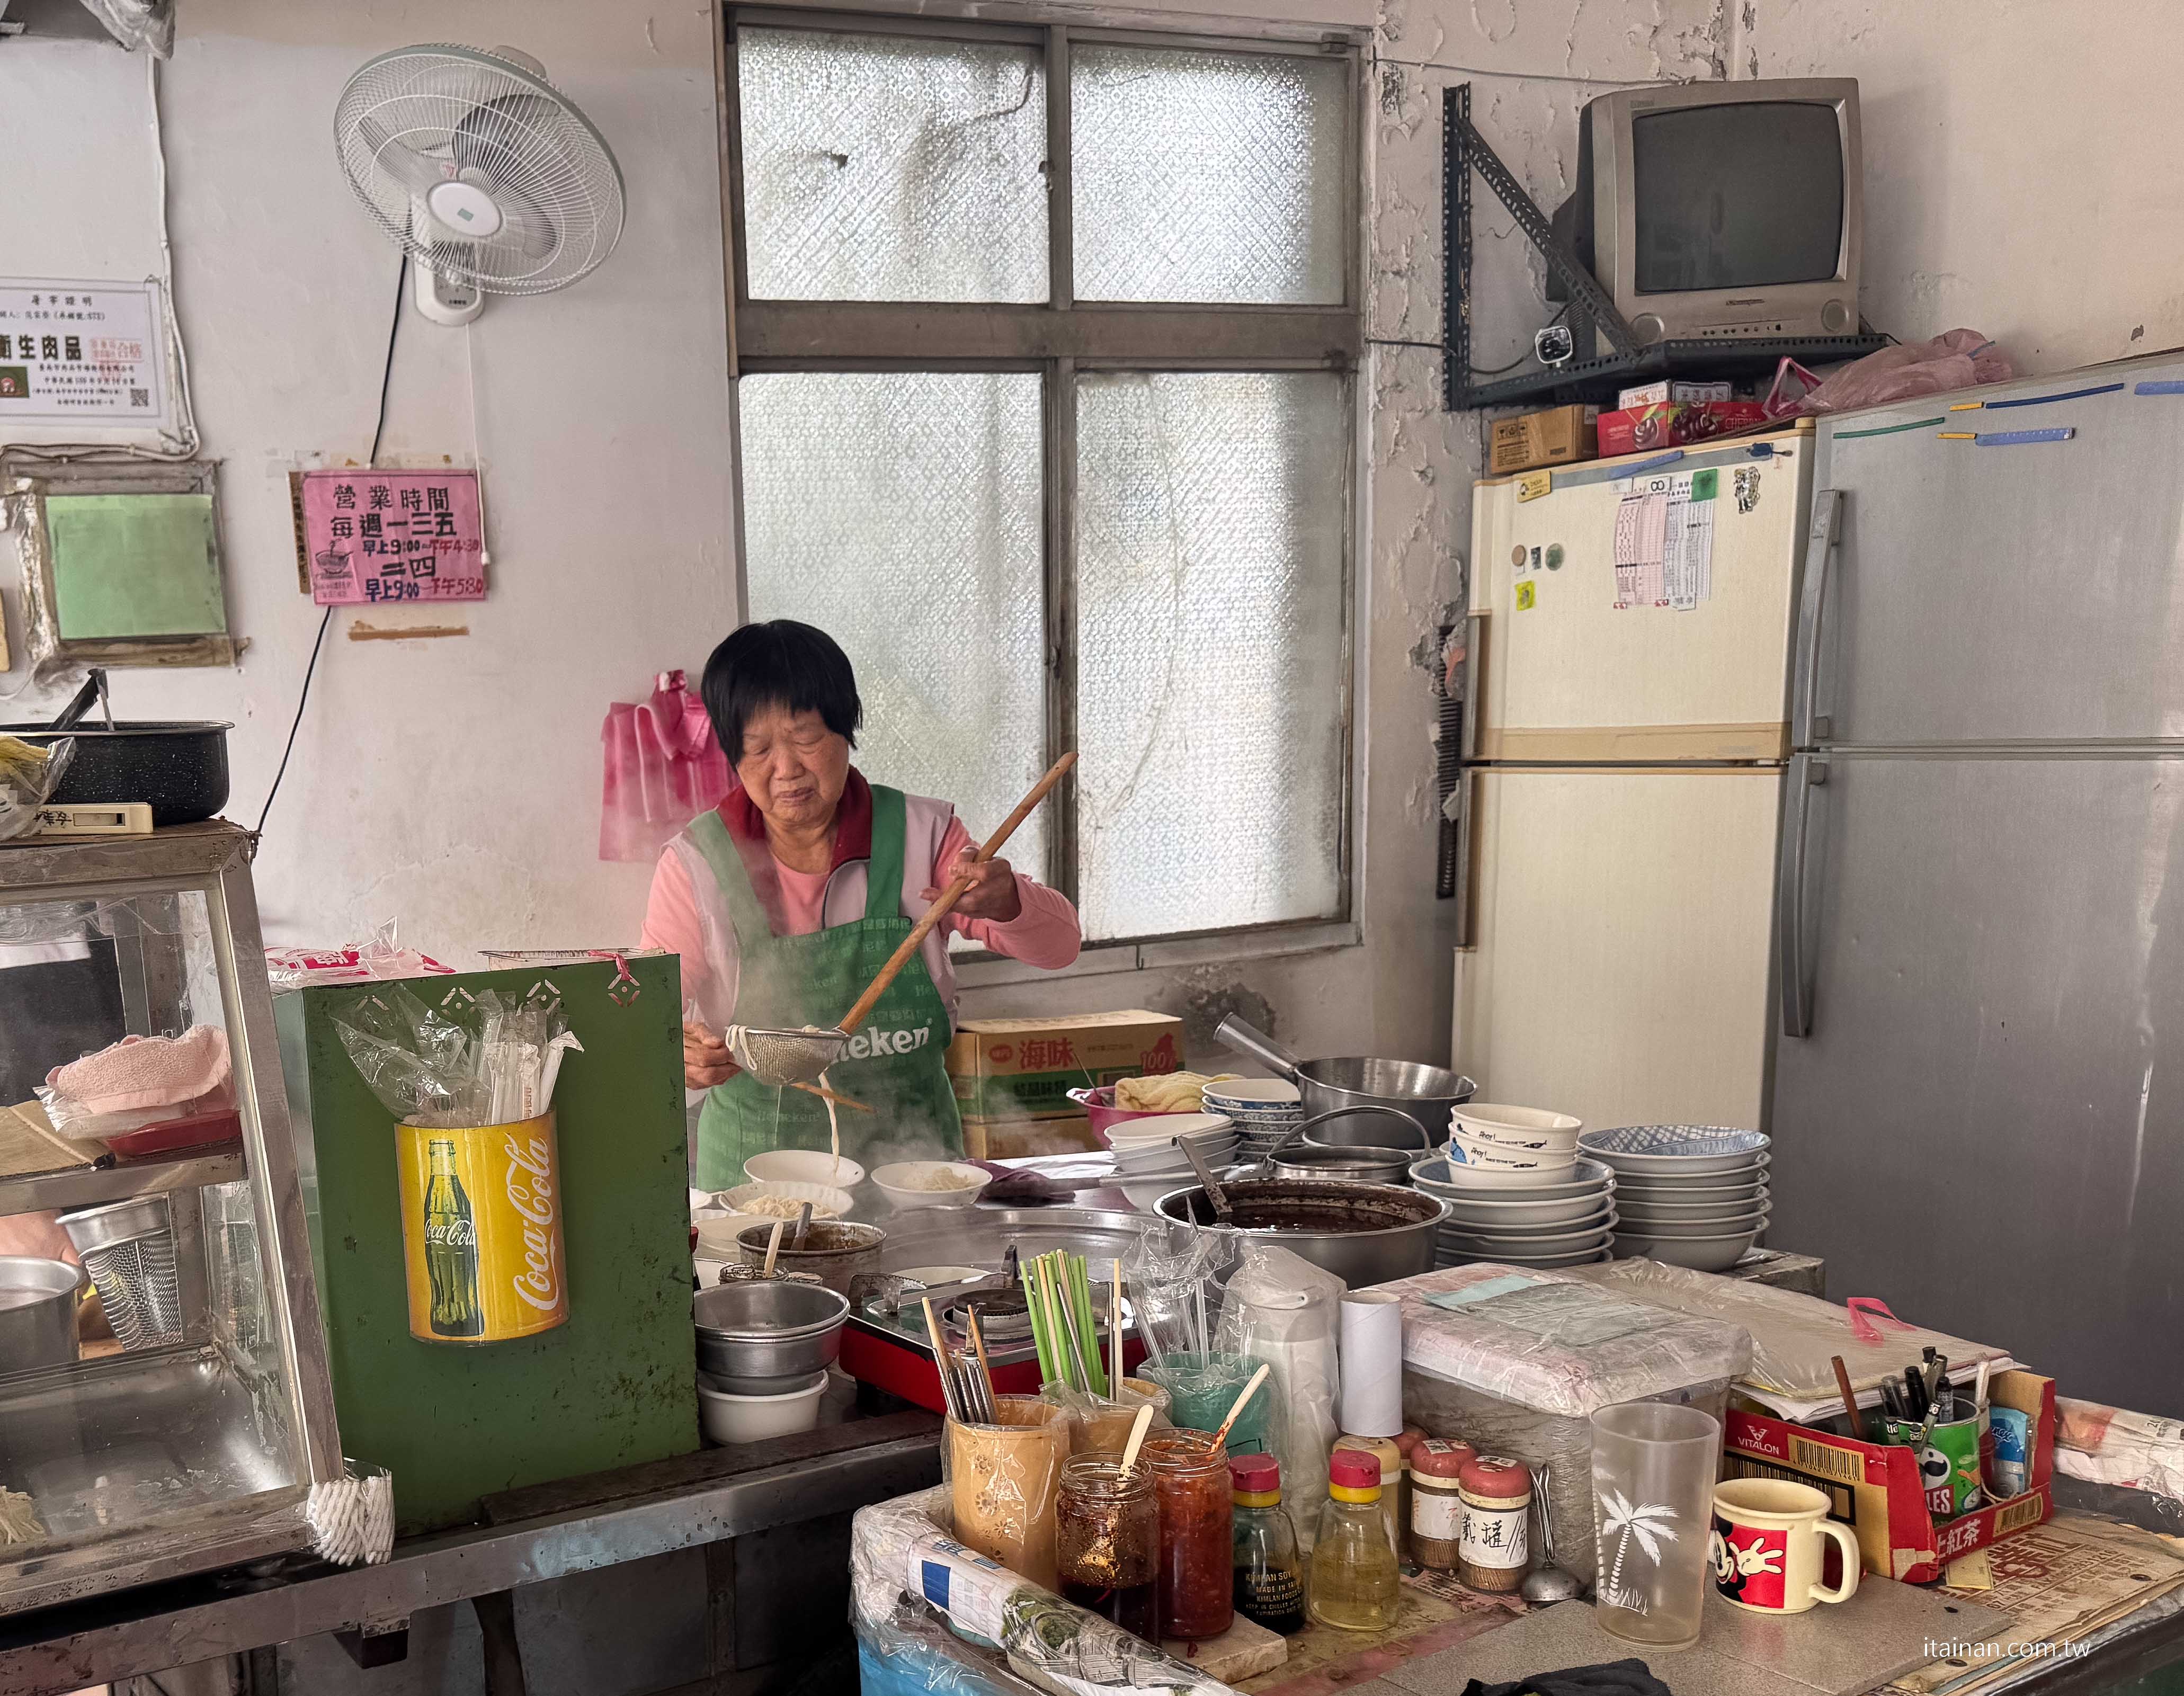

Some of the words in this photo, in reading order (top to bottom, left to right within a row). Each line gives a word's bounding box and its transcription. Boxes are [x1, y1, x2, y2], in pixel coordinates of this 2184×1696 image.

[333, 484, 449, 511] 營業時間
[330, 512, 457, 538] 每週一三五
[380, 556, 435, 578] 二四
[832, 1026, 930, 1064] eken
[1019, 1037, 1074, 1070] 海味
[425, 1219, 475, 1246] Coca-Cola
[505, 1132, 558, 1310] Coca-Cola
[1738, 1436, 1779, 1455] VITALON
[1926, 1489, 1950, 1514] LES
[1278, 1569, 1291, 1581] SOY
